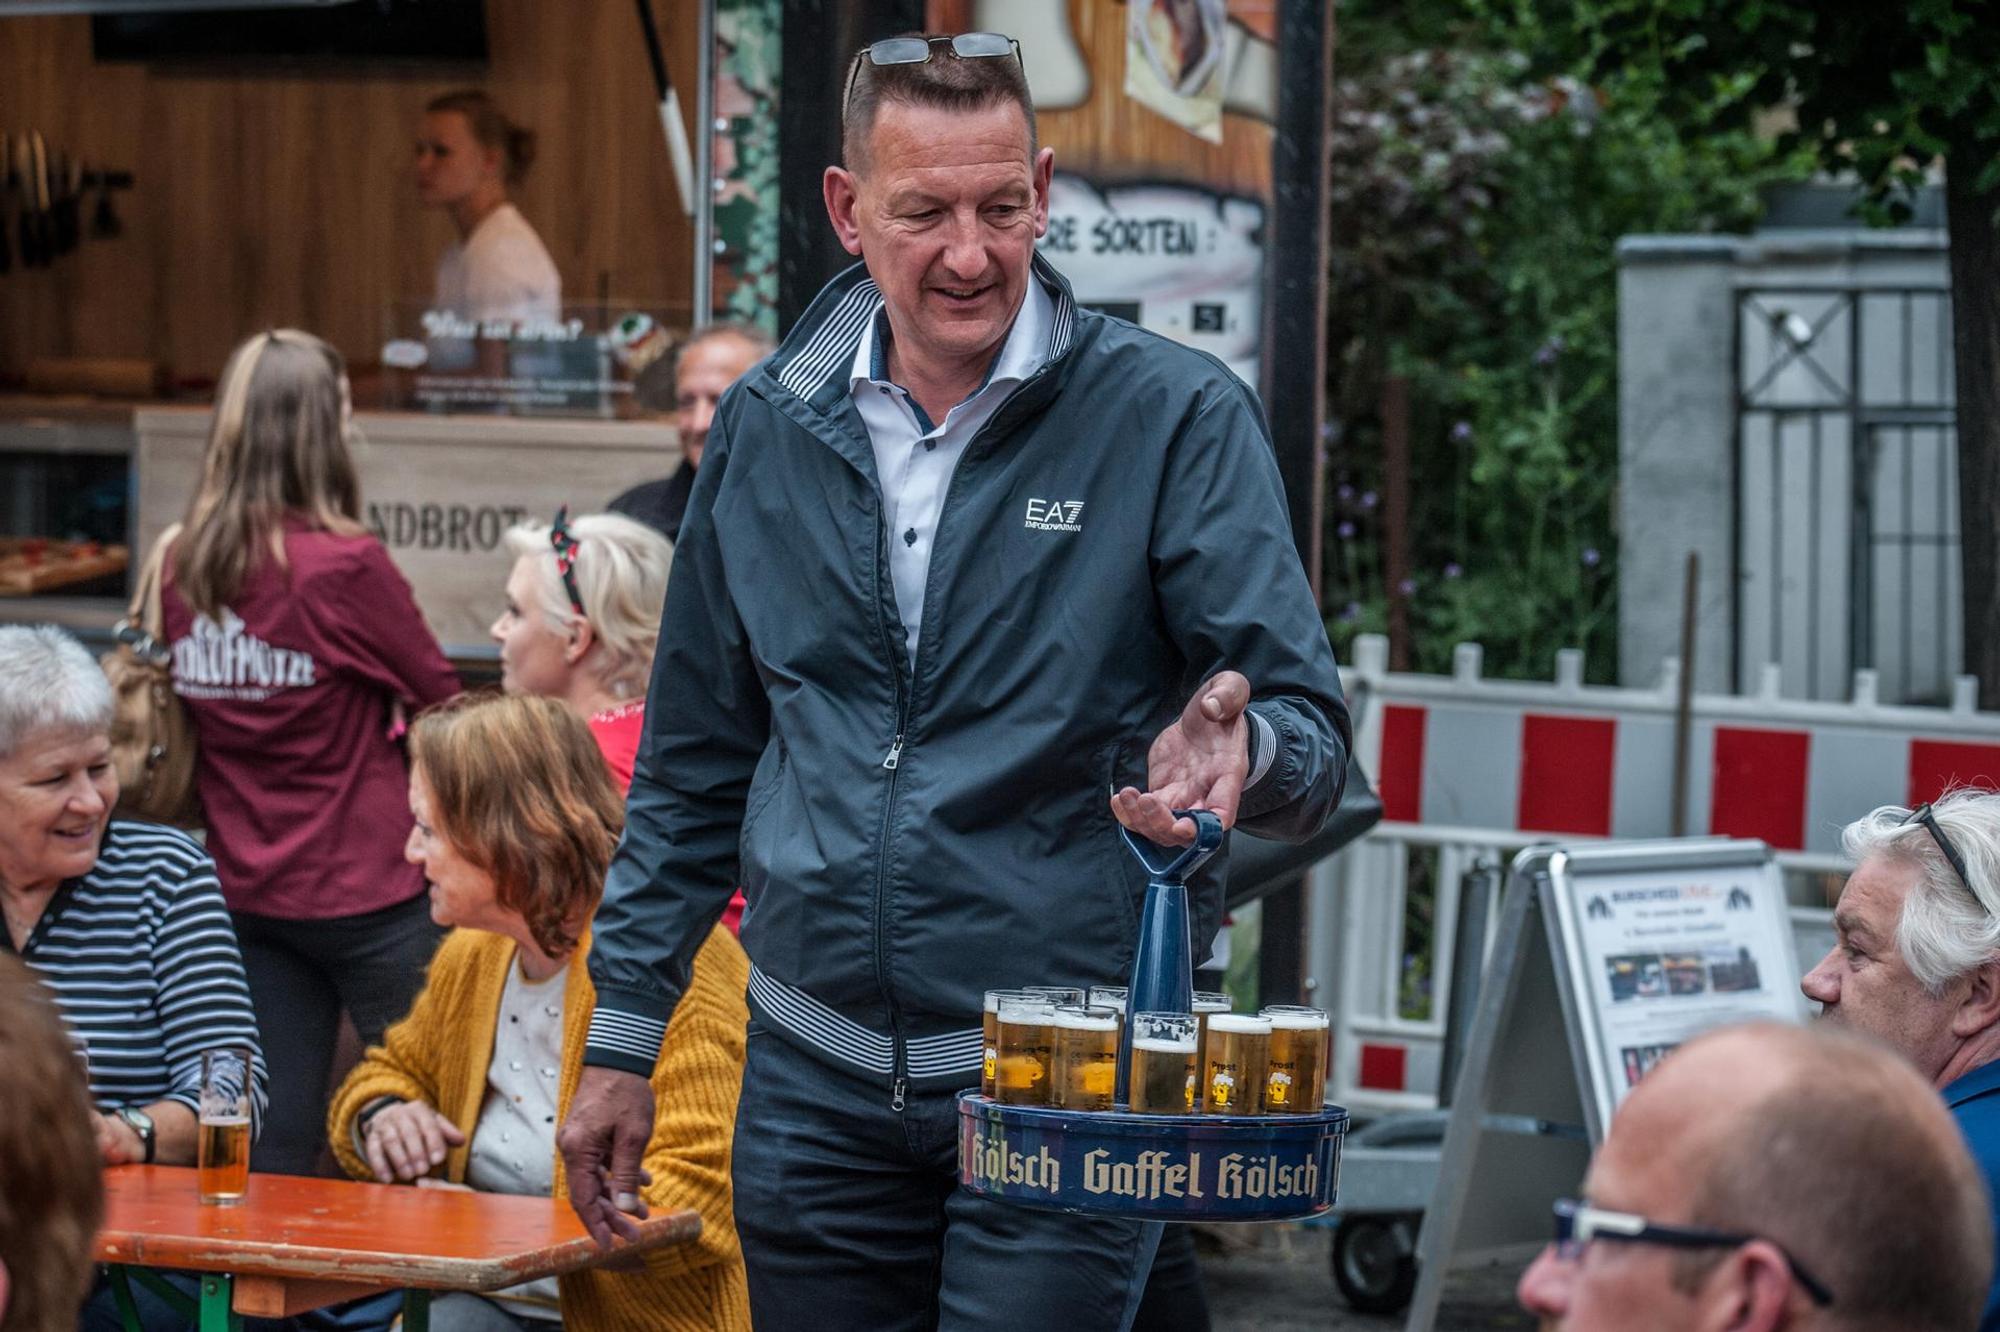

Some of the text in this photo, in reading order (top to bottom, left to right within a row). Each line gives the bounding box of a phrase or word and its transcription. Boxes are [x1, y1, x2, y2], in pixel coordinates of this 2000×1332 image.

[1046, 217, 1078, 252] RE
[1090, 215, 1198, 254] SORTEN
[368, 502, 527, 553] NDBROT
[1026, 498, 1085, 523] EA7
[1269, 1060, 1295, 1070] Prost
[973, 1132, 1318, 1201] Kölsch Gaffel Kölsch
